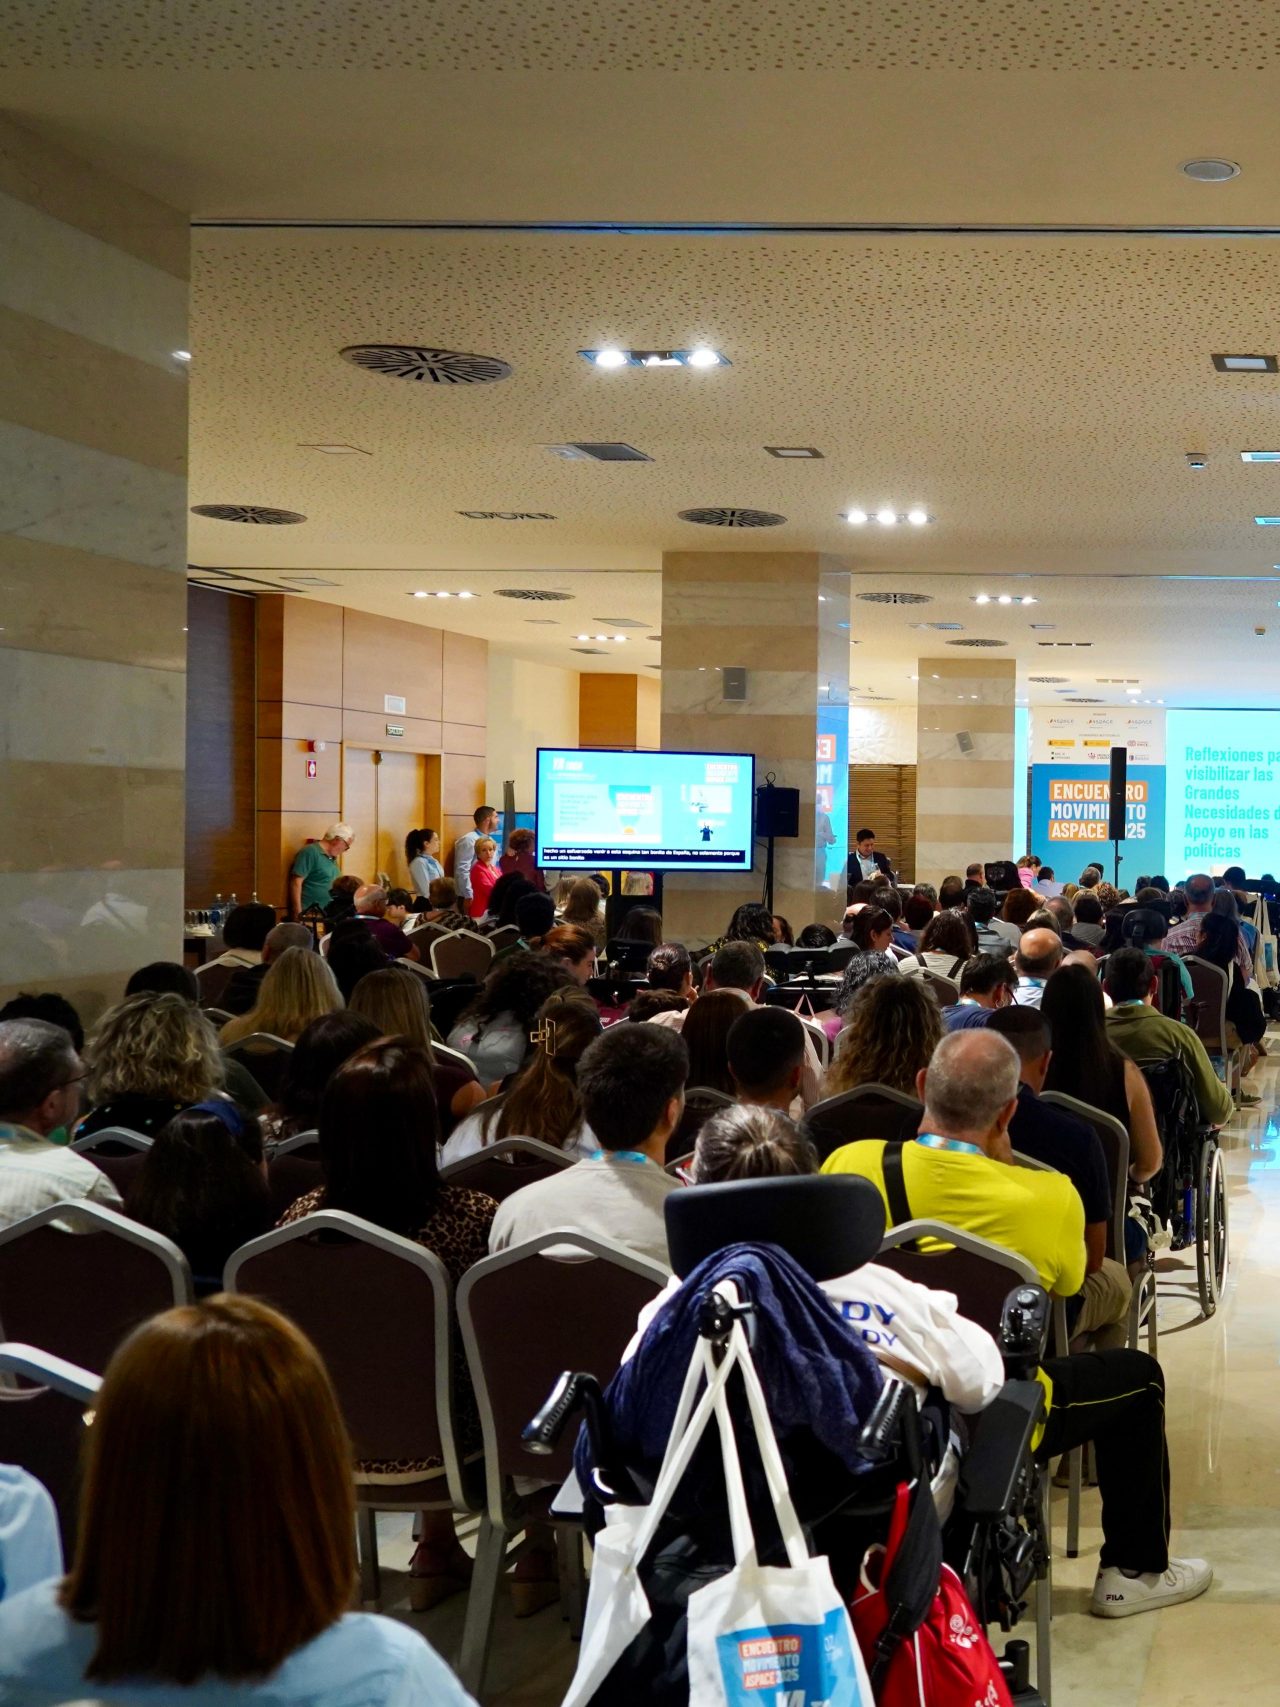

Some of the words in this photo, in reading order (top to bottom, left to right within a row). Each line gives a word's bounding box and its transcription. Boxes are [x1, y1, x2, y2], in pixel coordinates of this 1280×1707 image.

[1186, 747, 1263, 761] Reflexiones
[1186, 765, 1250, 781] visibilizar
[1254, 767, 1273, 781] las
[1054, 784, 1143, 800] ENCUENRO
[1185, 785, 1239, 800] Grandes
[1185, 804, 1269, 820] Necesidades
[1052, 823, 1105, 838] ASPACE
[1184, 824, 1225, 841] Apoyo
[1230, 828, 1245, 838] en
[1250, 824, 1269, 838] las
[742, 1637, 799, 1657] ENCUENTRO
[746, 1671, 776, 1688] ASPACE
